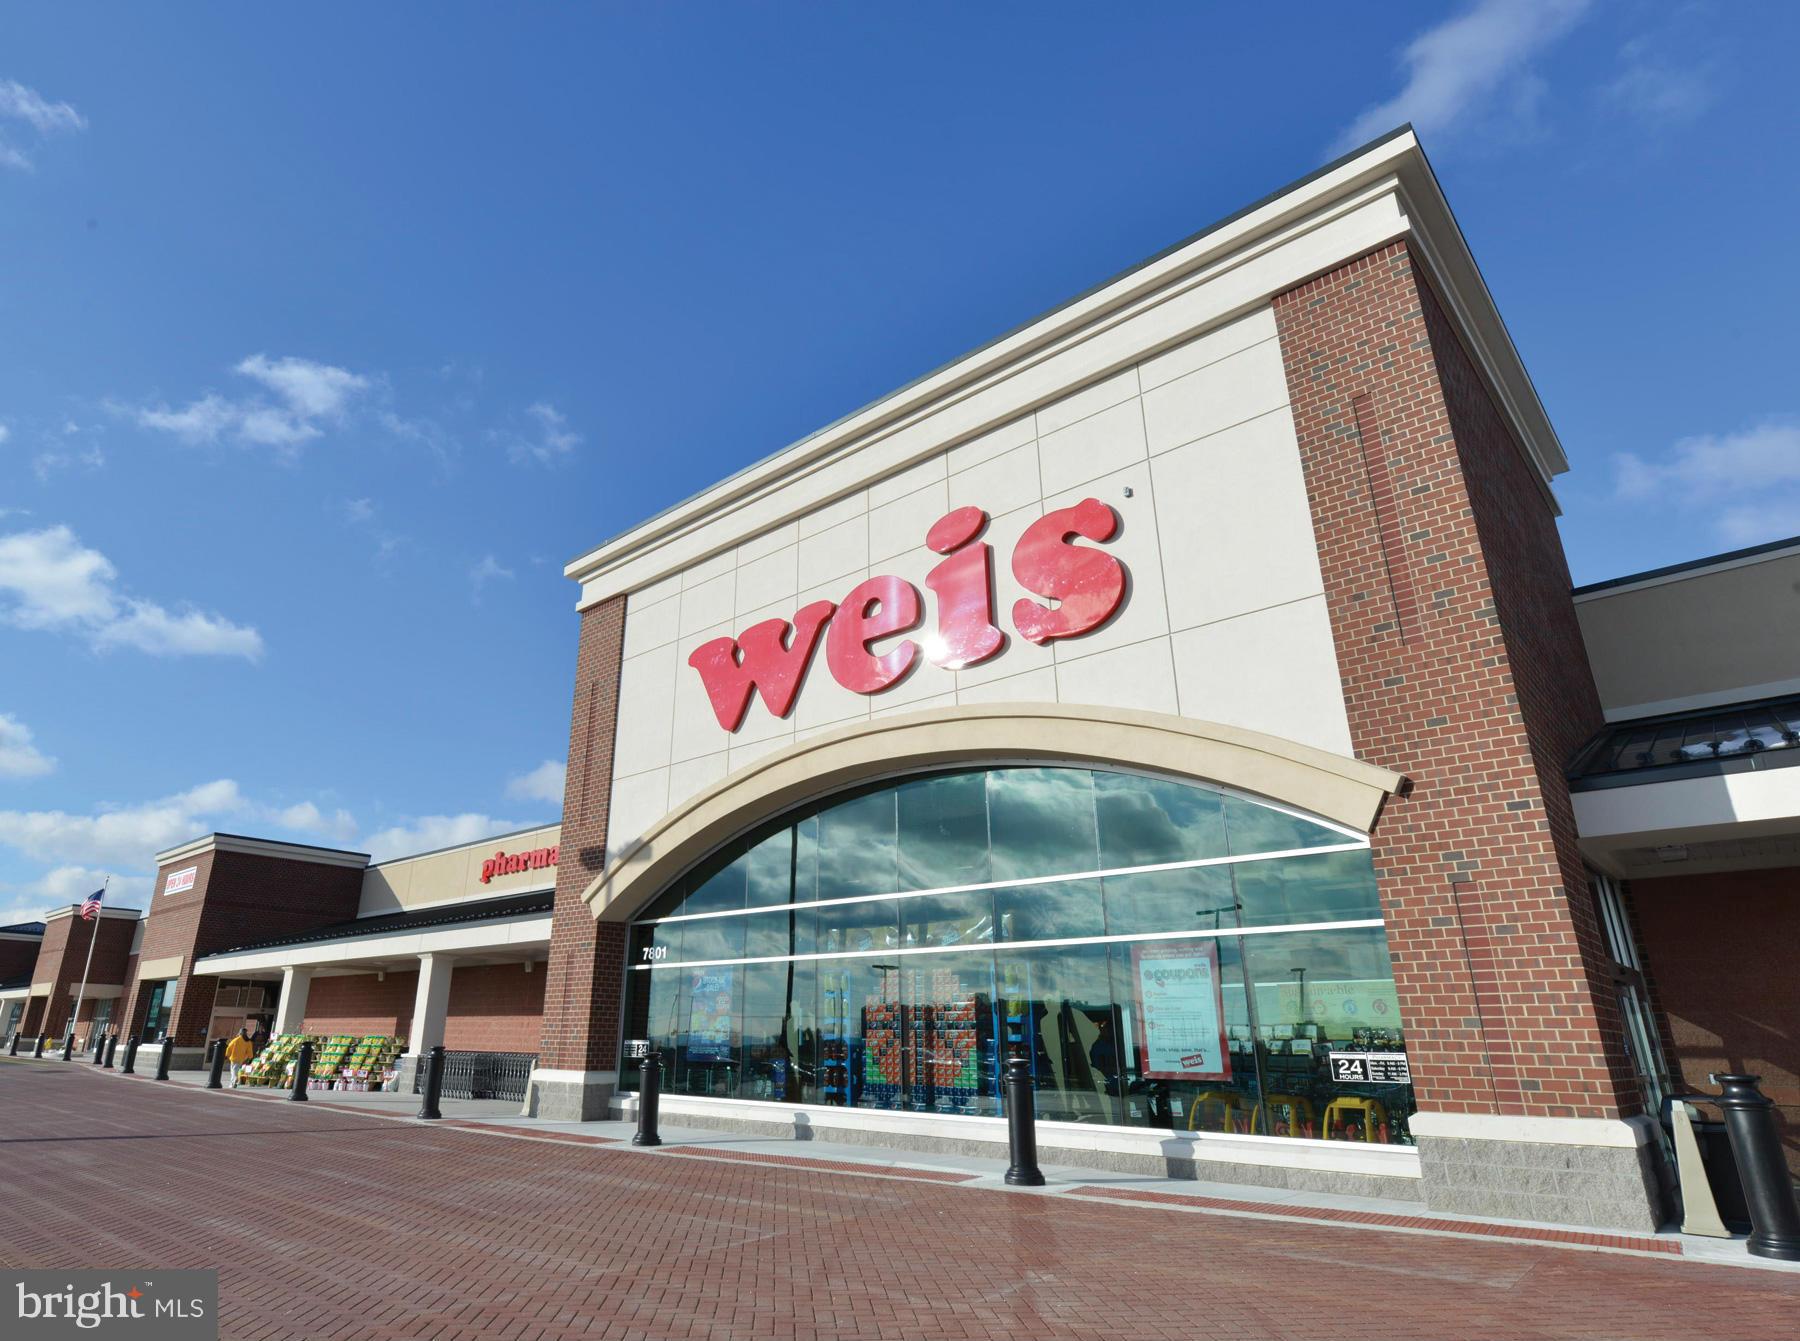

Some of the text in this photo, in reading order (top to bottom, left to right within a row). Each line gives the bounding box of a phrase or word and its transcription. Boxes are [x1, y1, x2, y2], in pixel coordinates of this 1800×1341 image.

[688, 498, 1127, 732] weis
[643, 946, 667, 960] 7801
[1338, 1060, 1362, 1074] 24
